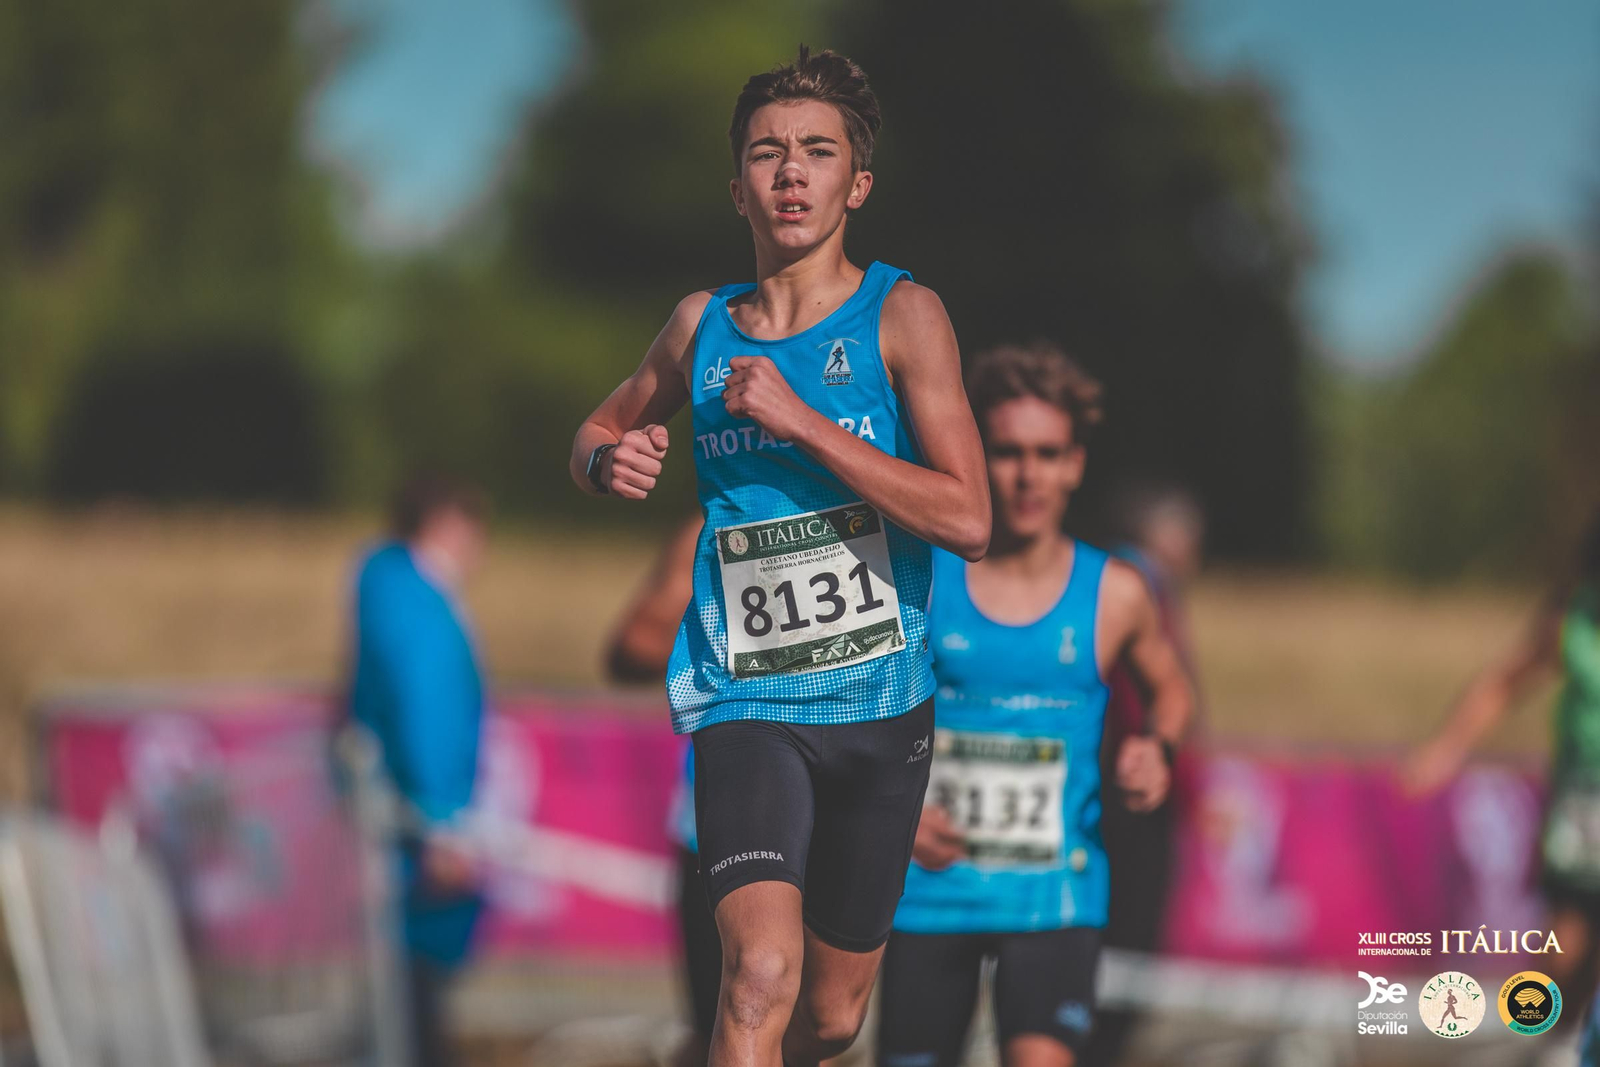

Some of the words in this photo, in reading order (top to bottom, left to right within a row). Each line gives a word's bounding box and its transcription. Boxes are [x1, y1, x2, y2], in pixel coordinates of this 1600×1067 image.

[757, 518, 837, 547] ITÁLICA
[759, 561, 798, 573] TROTASIERRA
[797, 550, 846, 566] HORNACHUELOS
[760, 553, 798, 566] CAYETANO
[799, 548, 824, 559] UBEDA
[824, 544, 841, 553] FIJO
[740, 561, 884, 638] 8131
[709, 850, 784, 876] TROTASIERRA
